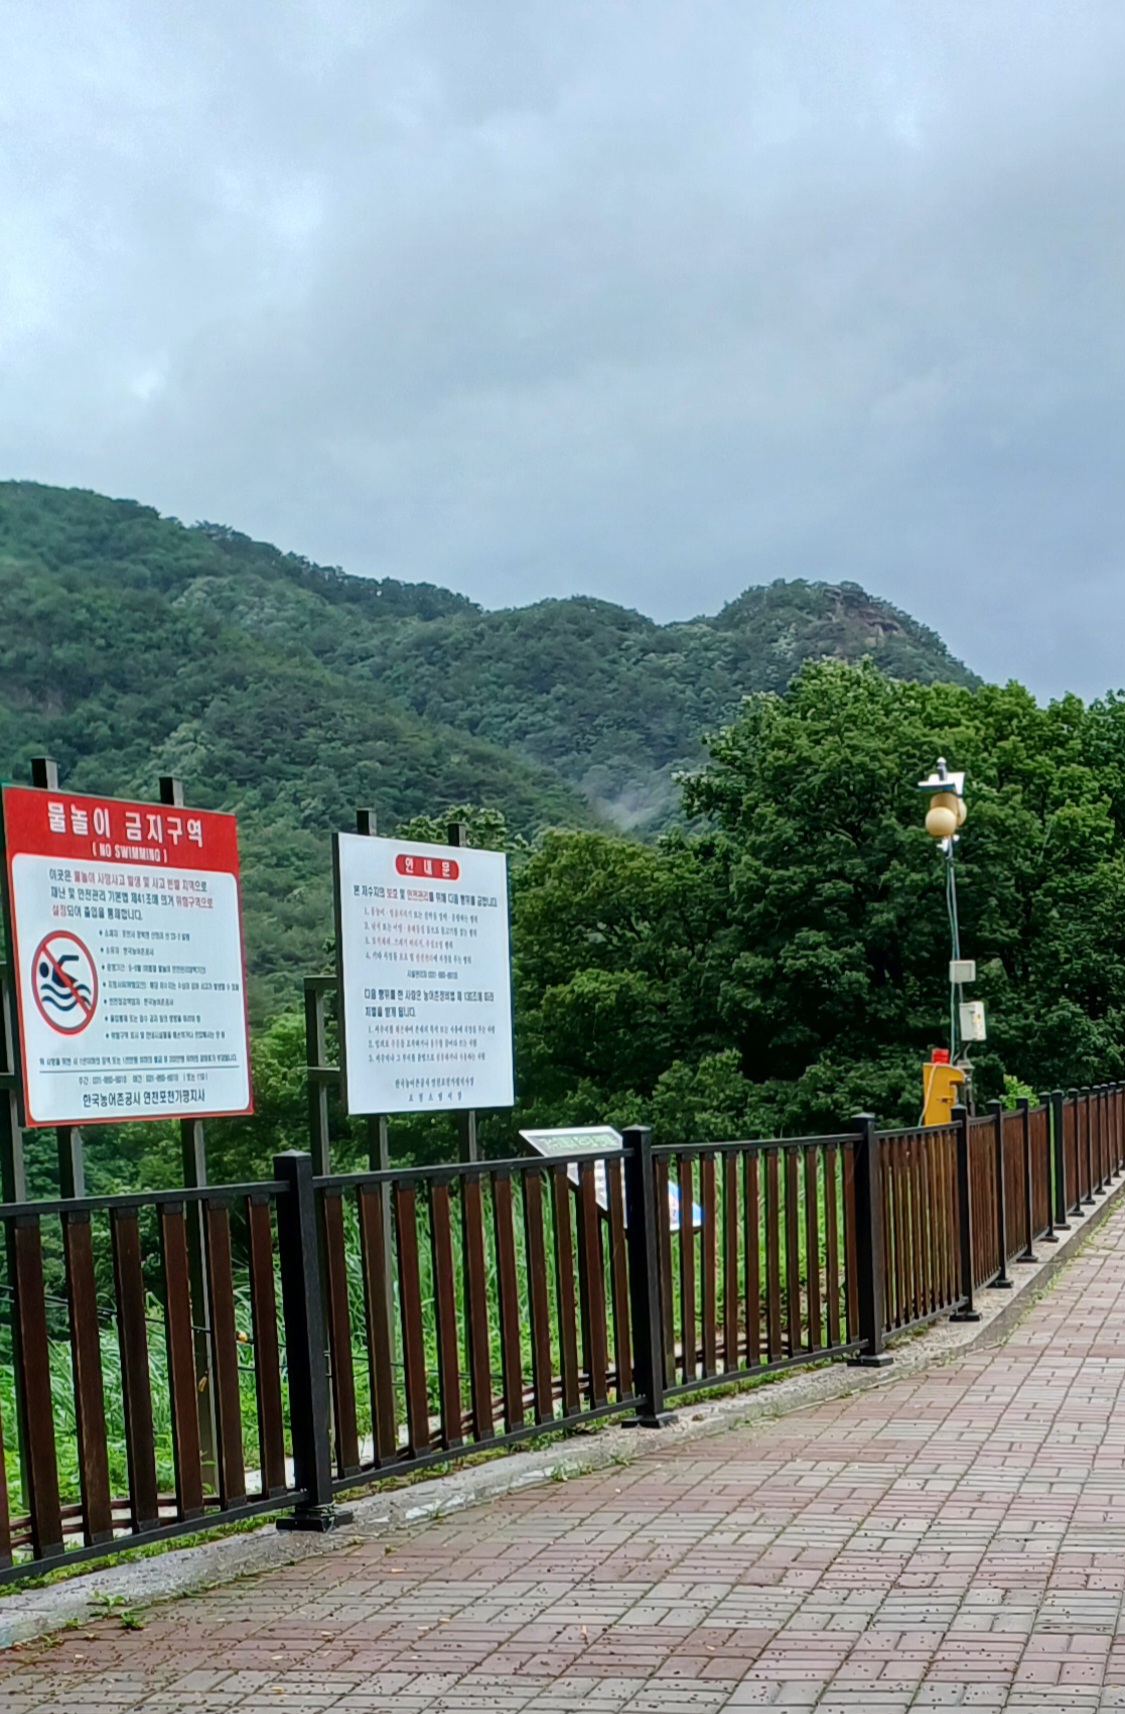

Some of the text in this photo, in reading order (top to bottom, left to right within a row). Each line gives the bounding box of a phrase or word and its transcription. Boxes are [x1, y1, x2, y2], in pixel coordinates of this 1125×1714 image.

[48, 801, 203, 848] 물놀이 금지구역
[114, 844, 161, 862] SWIMMING
[49, 868, 72, 882] 이곳은
[82, 1088, 205, 1108] 한국농어촌공사 연천포천가평지사
